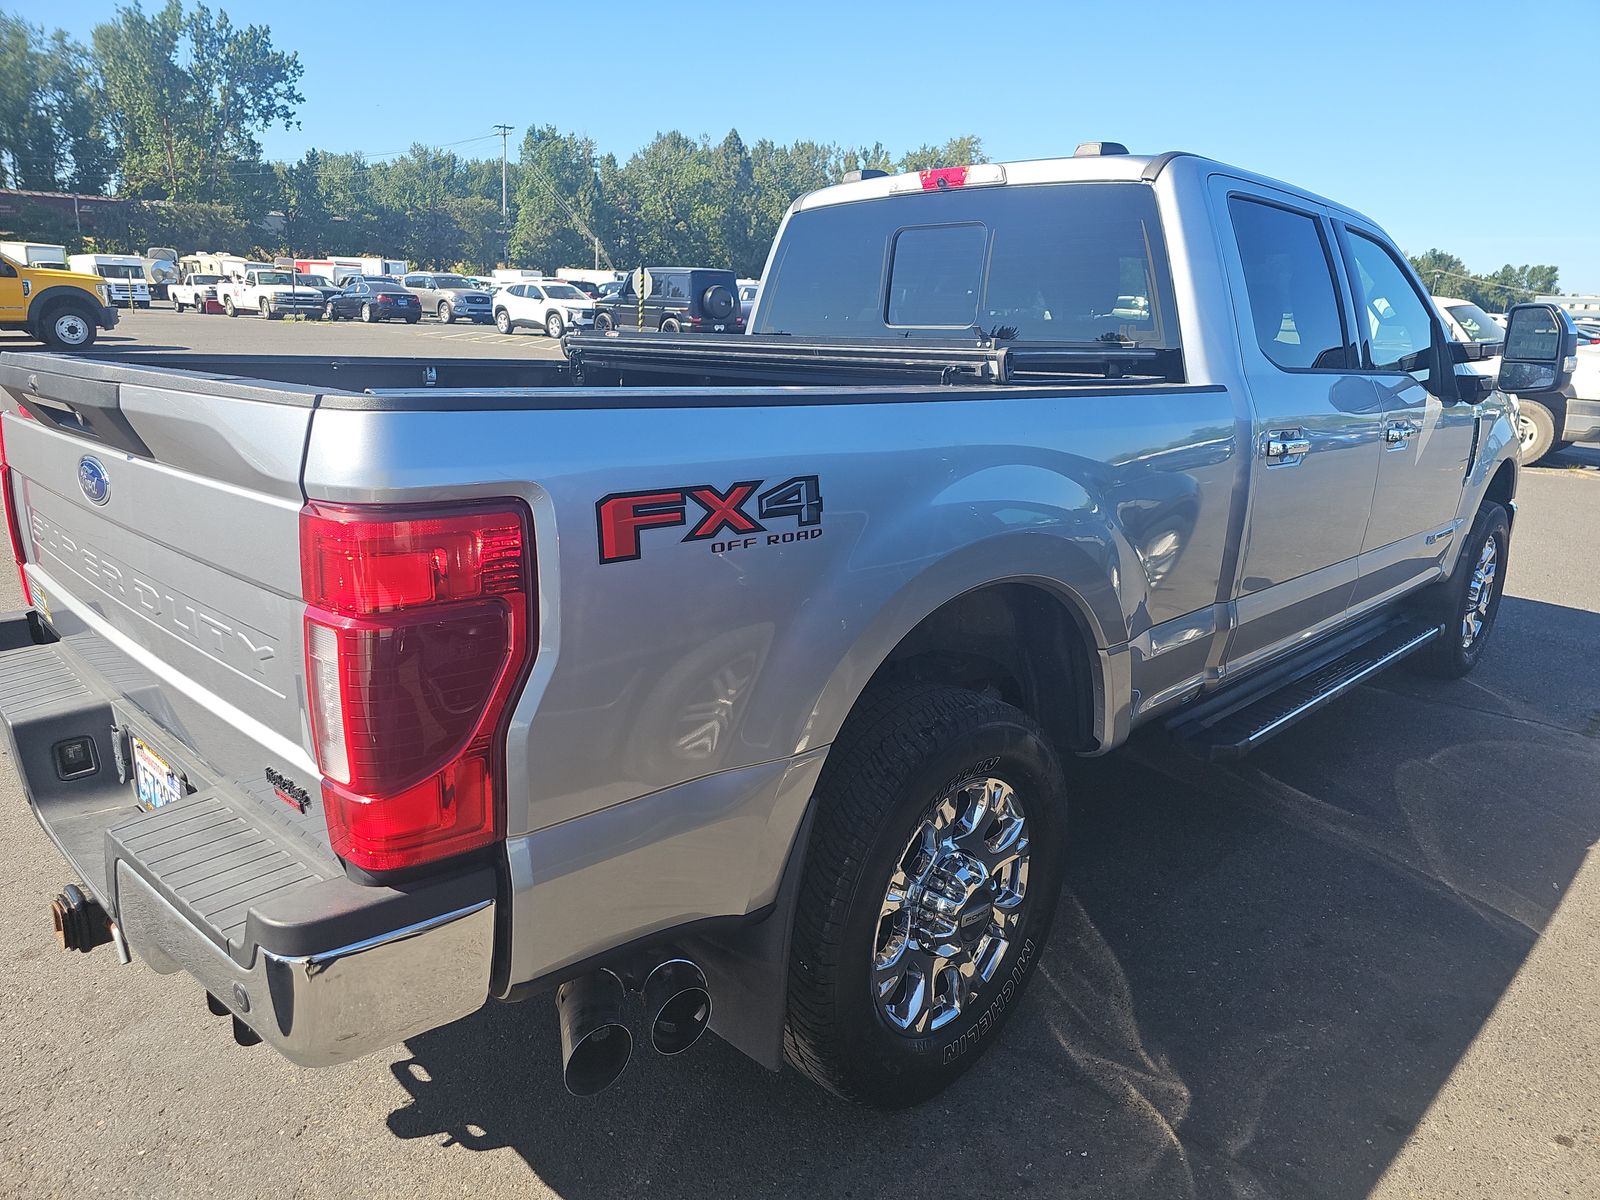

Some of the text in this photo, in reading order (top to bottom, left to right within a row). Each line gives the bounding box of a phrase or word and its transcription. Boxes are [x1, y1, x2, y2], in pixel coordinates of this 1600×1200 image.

[595, 474, 823, 565] FX4
[710, 528, 823, 554] OFF ROAD
[31, 514, 275, 675] SUPER DUTY
[942, 938, 1036, 1065] MICHELIN
